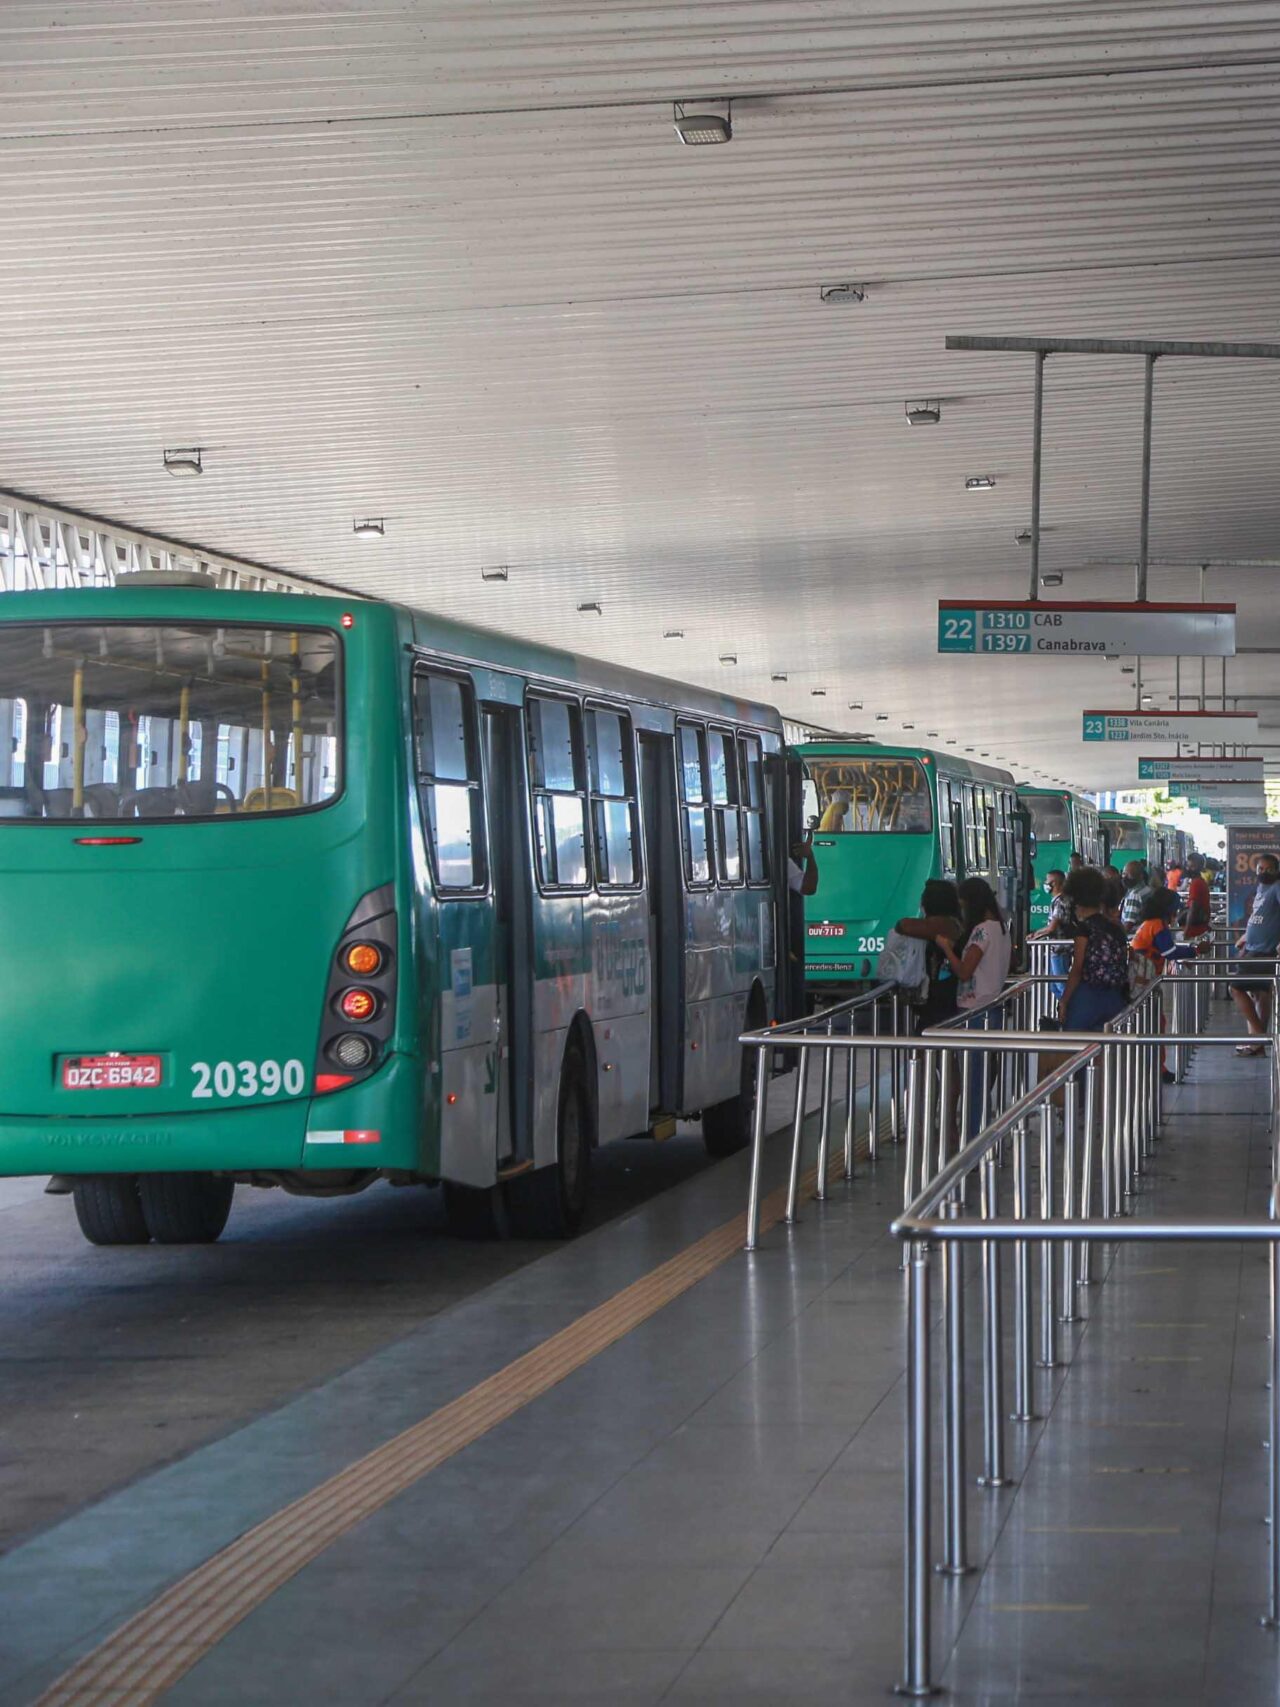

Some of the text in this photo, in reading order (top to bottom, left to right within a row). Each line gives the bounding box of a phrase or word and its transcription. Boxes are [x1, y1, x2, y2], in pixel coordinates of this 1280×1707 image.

[986, 613, 1063, 628] 1310 CAB
[944, 619, 973, 640] 22
[985, 635, 1106, 652] 1397 Canabrava
[1085, 721, 1103, 734] 23
[1129, 719, 1143, 728] Vila
[1130, 732, 1152, 741] Jardim
[1142, 765, 1154, 775] 24
[190, 1059, 305, 1099] 20390
